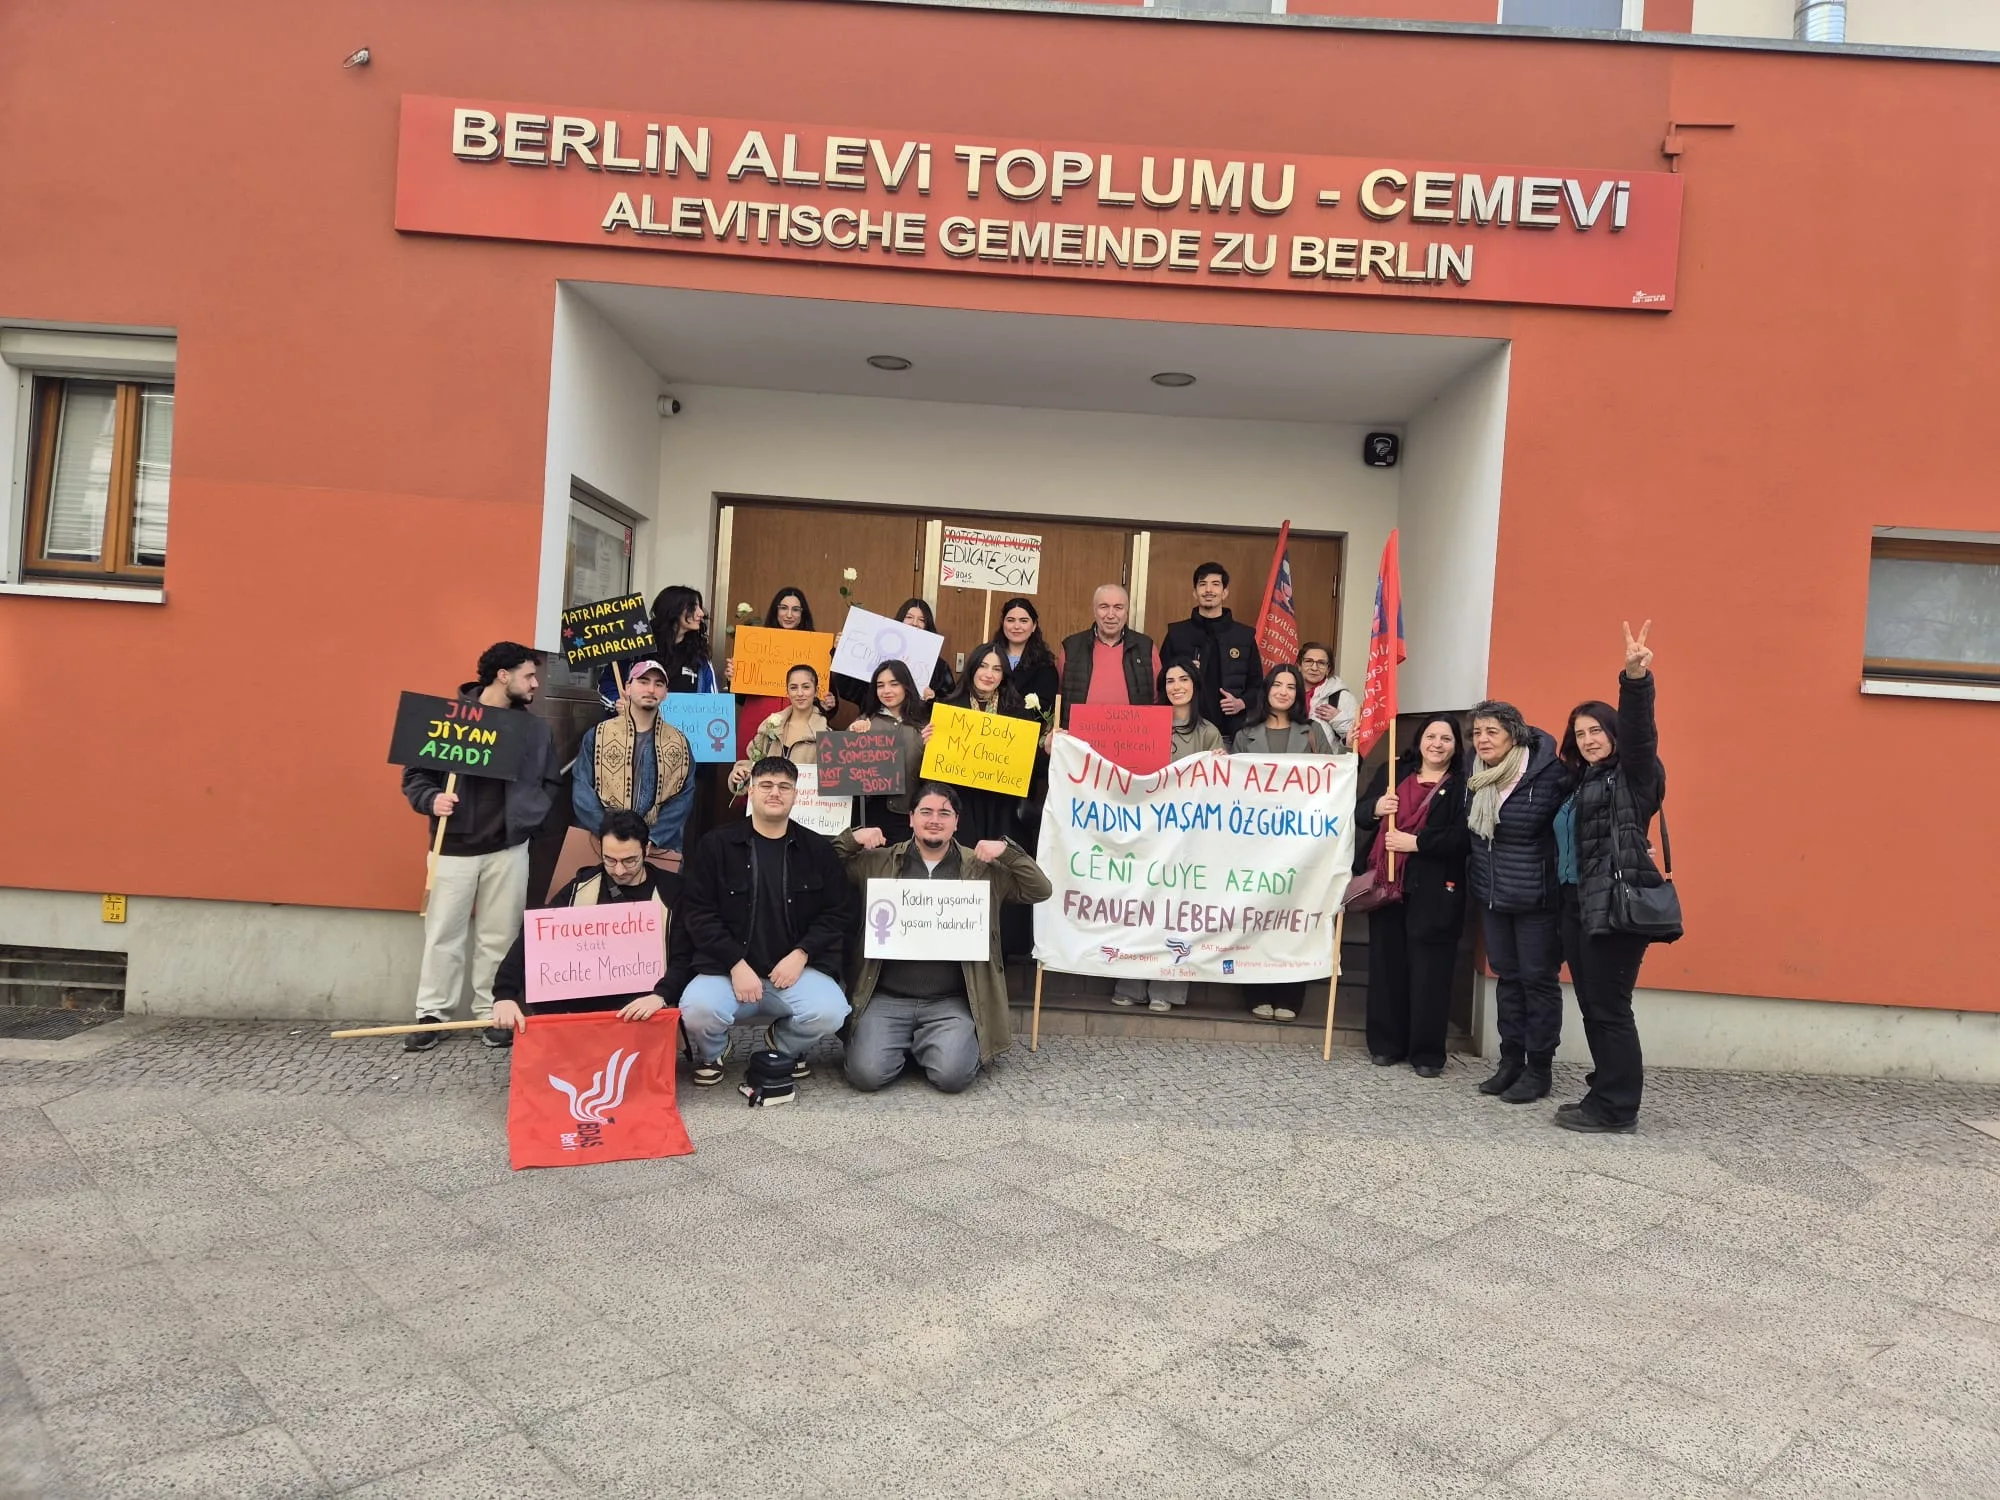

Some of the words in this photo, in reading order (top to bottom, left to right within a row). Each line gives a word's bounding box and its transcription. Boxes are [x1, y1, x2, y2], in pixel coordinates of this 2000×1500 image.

[953, 143, 1296, 215] TOPLUMU
[1316, 189, 1341, 206] -
[601, 191, 926, 252] ALEVITISCHE
[938, 216, 1202, 272] GEMEINDE
[1209, 231, 1278, 275] ZU
[1290, 234, 1473, 285] BERLIN
[943, 543, 1001, 570] EDUCATE
[987, 565, 1036, 586] SON
[561, 596, 644, 625] MATRIARCHAT
[584, 619, 625, 639] STATT
[567, 634, 654, 665] PATRIARCHAT
[444, 701, 484, 722] JIN
[427, 720, 498, 746] JÎYAN
[819, 736, 833, 749] A
[843, 735, 896, 749] WOMEN
[950, 711, 975, 742] My
[980, 716, 1016, 748] Body
[418, 740, 492, 767] AZADÎ
[838, 749, 898, 765] SOMEBODY
[947, 735, 971, 761] My
[973, 742, 1010, 765] Choice
[849, 767, 880, 781] SOME
[934, 753, 968, 778] Raise
[972, 769, 994, 785] your
[996, 769, 1024, 789] Voice
[1067, 752, 1134, 795] JIN
[1243, 761, 1338, 795] AZADÎ
[1071, 797, 1142, 833] KADIN
[1149, 801, 1222, 833] YAŞAM
[1228, 800, 1340, 838] ÖZGÜRLÜK
[1069, 845, 1136, 884] CÊNÎ
[1147, 860, 1207, 891] CUYE
[1225, 867, 1299, 896] AZADÎ
[535, 912, 656, 941] Frauenrechte
[1063, 889, 1155, 929] FRAUEN
[1164, 898, 1237, 934] LEBEN
[1242, 905, 1324, 935] FREIHEIT
[576, 939, 607, 952] statt
[540, 961, 592, 987] Rechte
[598, 952, 662, 982] Menschen
[577, 1122, 604, 1148] BDAS
